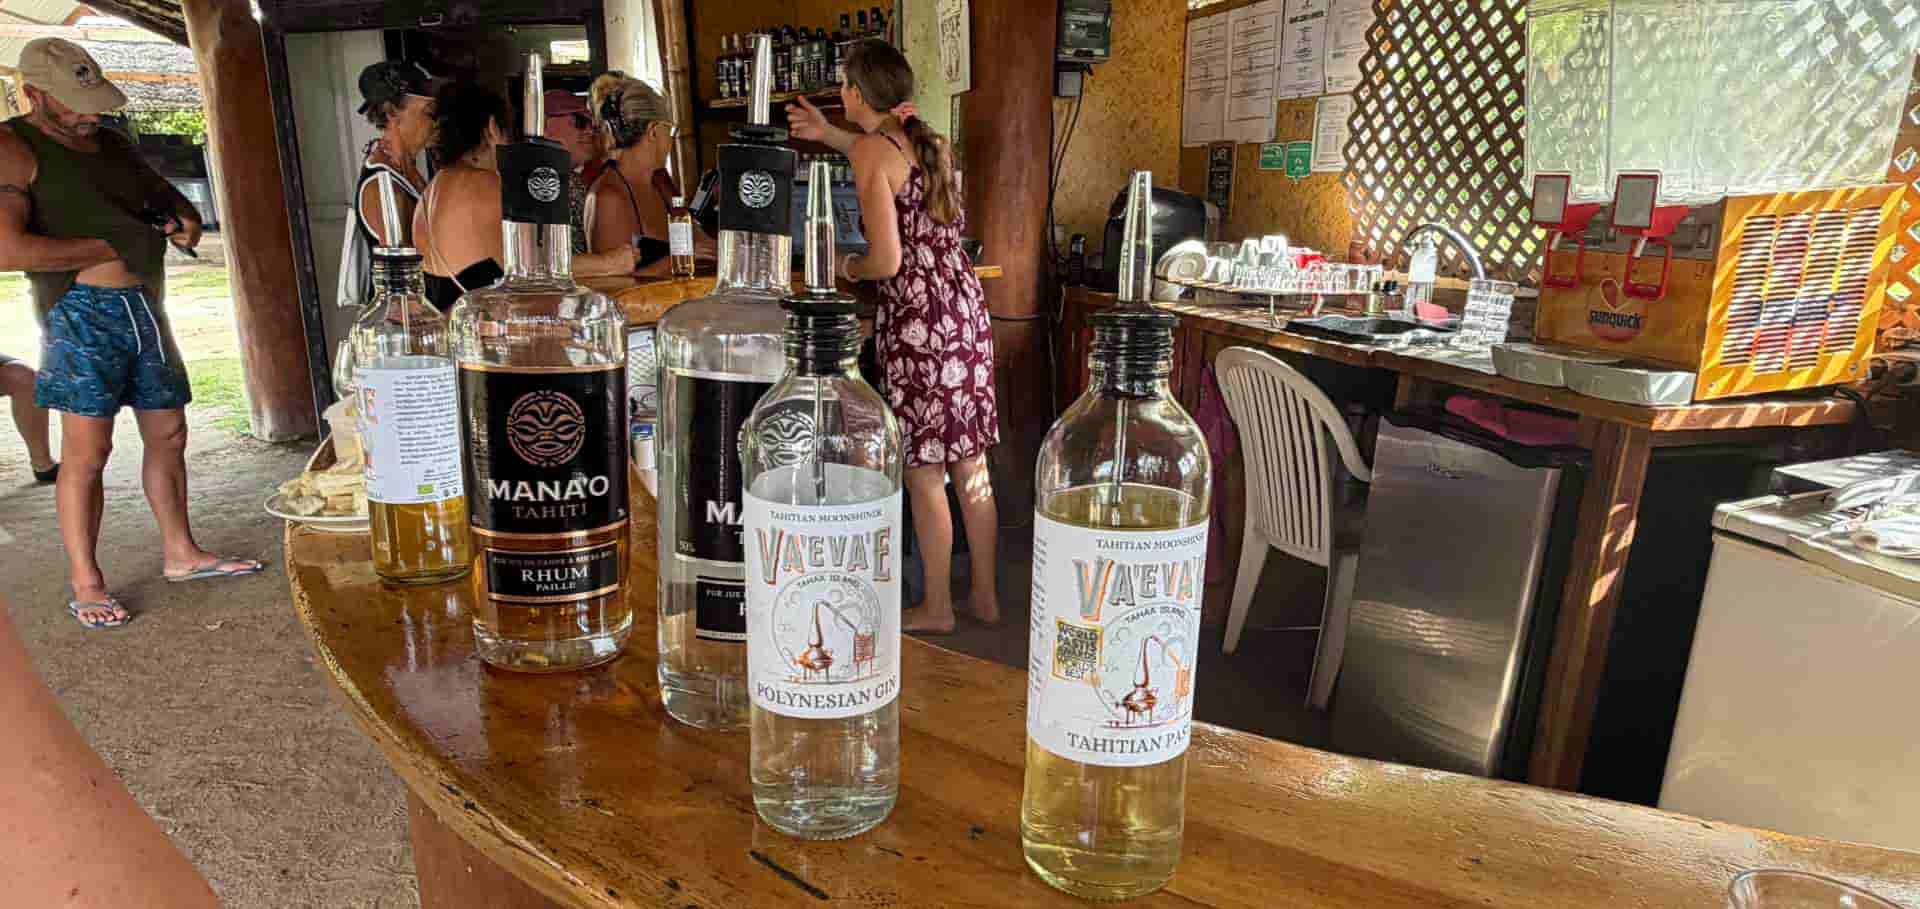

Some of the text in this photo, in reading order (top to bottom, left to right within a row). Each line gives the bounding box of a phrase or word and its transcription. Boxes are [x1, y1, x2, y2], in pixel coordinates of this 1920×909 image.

[512, 502, 588, 520] TAHITI
[1096, 538, 1151, 551] TAHITIAN
[521, 565, 589, 582] RHUM
[757, 674, 898, 709] POLYNESIAN GIN
[1067, 732, 1162, 754] TAHITIAN
